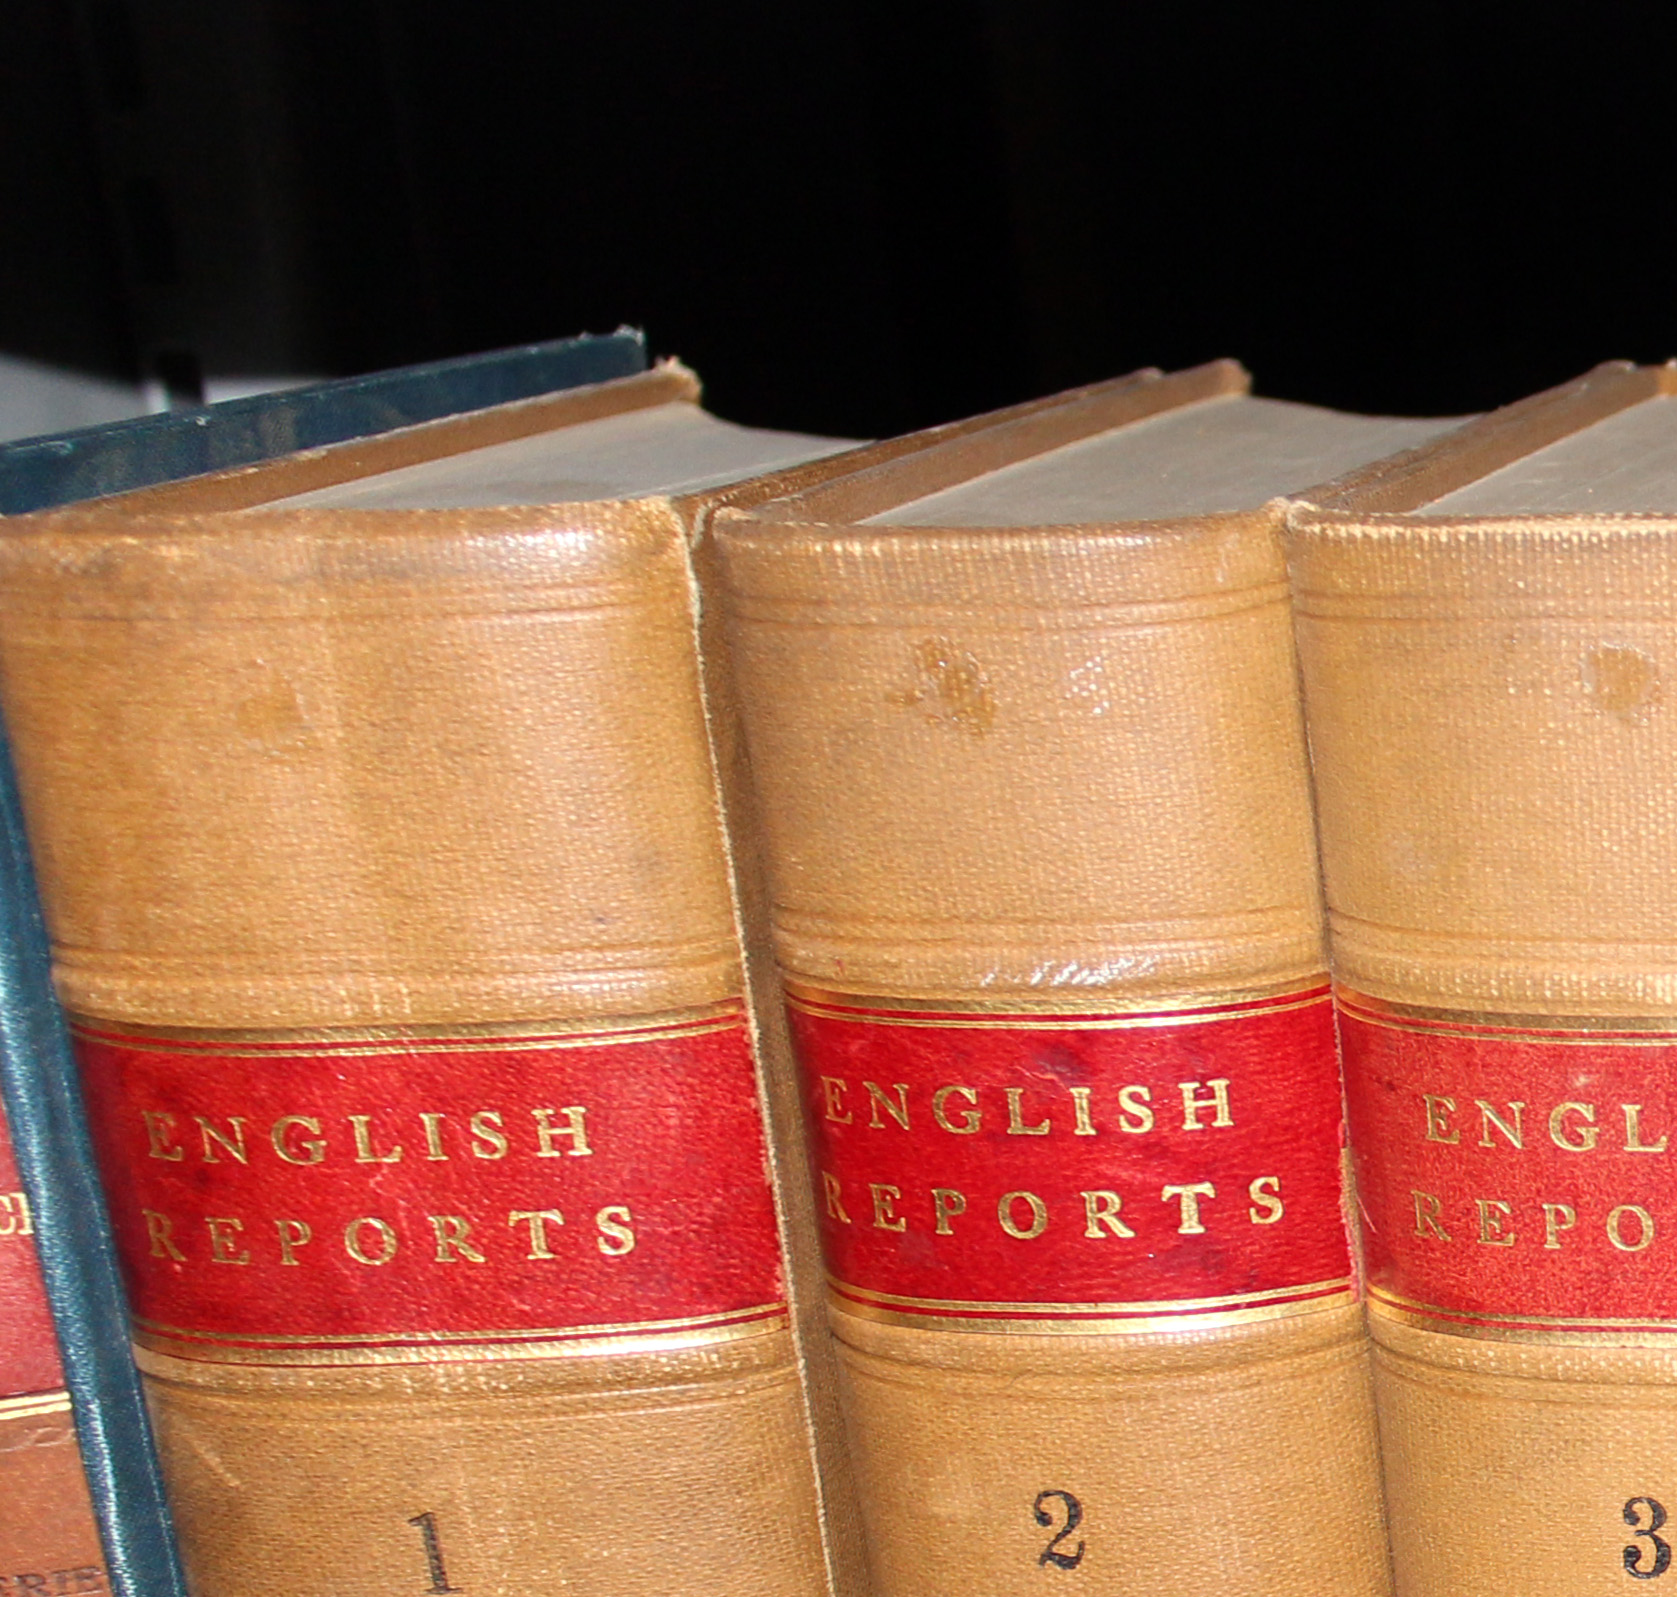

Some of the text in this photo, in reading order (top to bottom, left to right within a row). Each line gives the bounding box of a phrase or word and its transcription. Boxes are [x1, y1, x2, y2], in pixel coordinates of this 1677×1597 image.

[143, 1106, 593, 1166] ENGLISH
[822, 1076, 1236, 1137] ENGLISH
[143, 1204, 637, 1267] REPORTS
[824, 1174, 1287, 1240] REPORTS
[407, 1511, 463, 1595] 1
[1033, 1490, 1086, 1570] 2
[1622, 1497, 1672, 1579] 3
